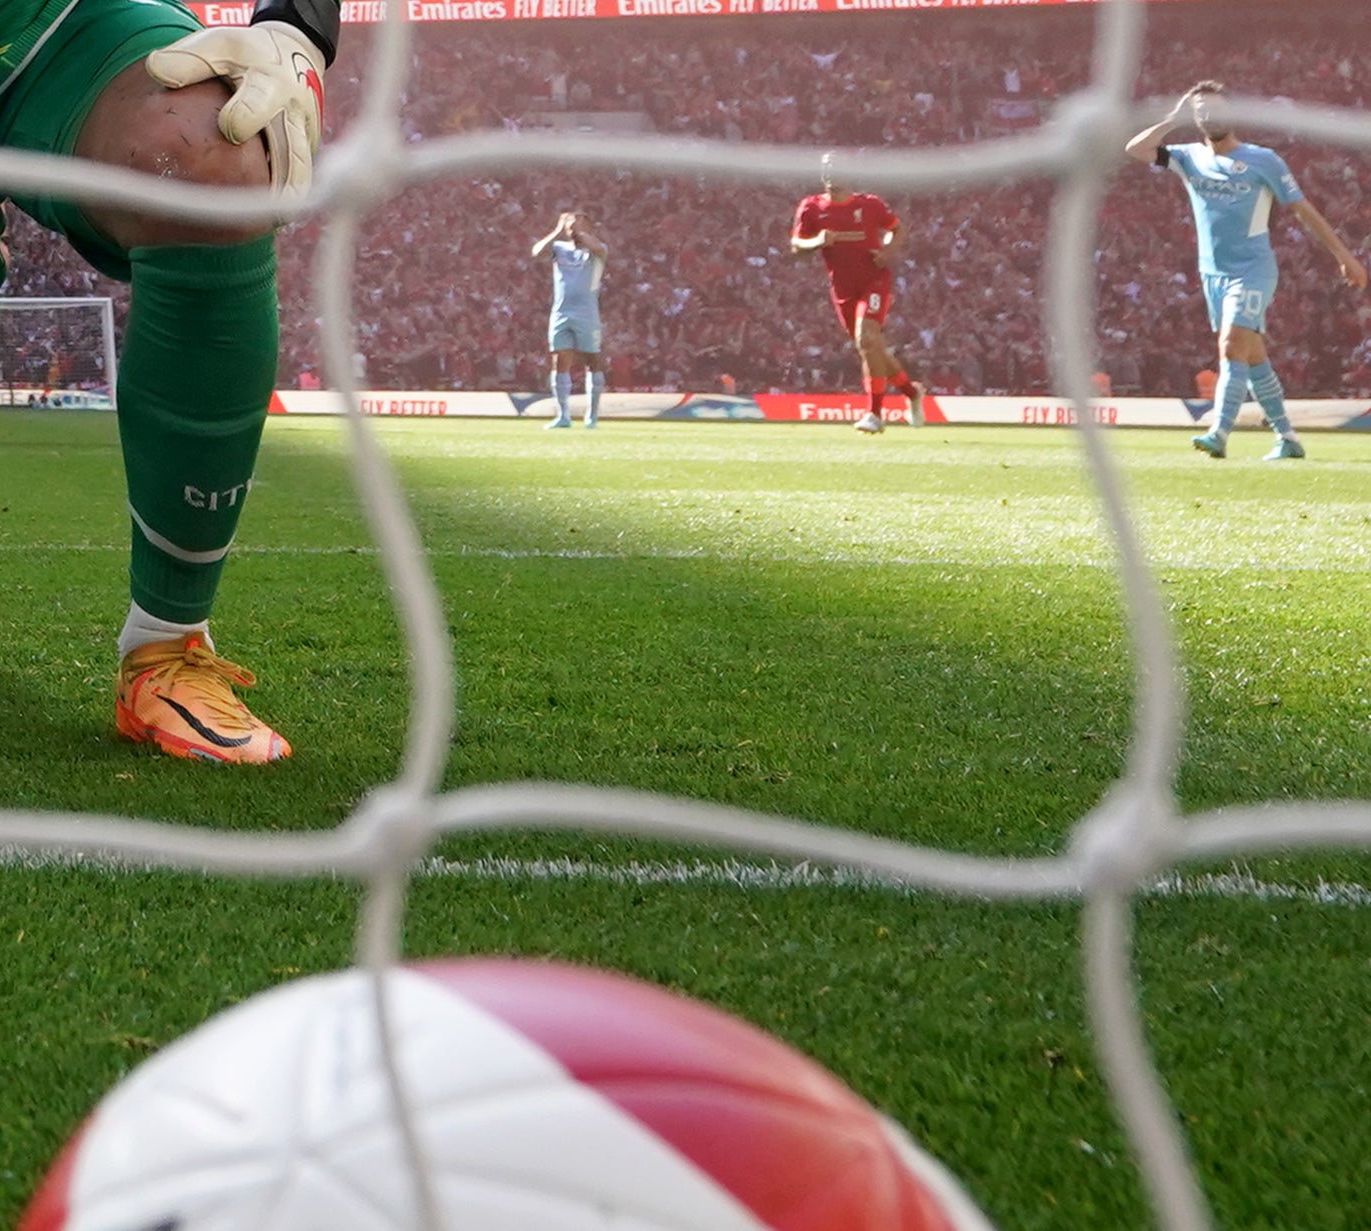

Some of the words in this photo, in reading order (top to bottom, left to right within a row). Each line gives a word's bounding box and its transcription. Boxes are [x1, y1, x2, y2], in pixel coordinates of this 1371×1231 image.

[408, 0, 506, 20] Emirates
[390, 400, 447, 416] BETTER
[1023, 406, 1051, 424] FLY
[1056, 406, 1118, 425] BETER
